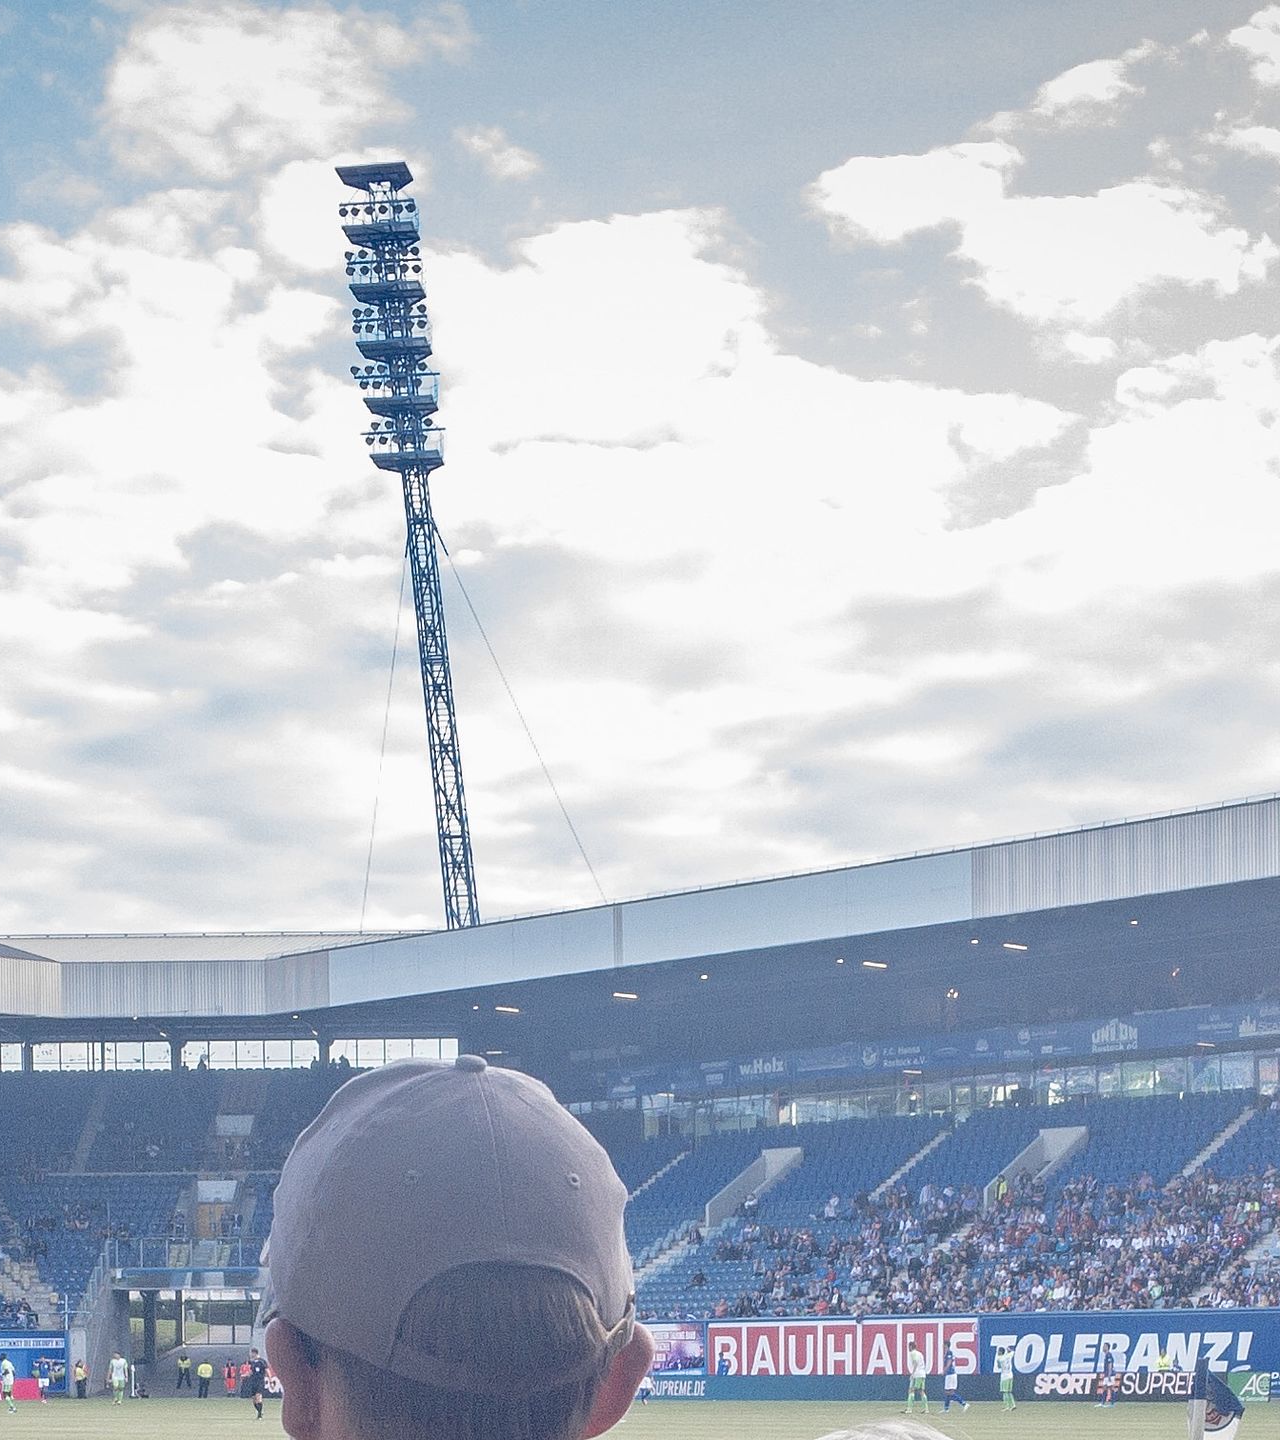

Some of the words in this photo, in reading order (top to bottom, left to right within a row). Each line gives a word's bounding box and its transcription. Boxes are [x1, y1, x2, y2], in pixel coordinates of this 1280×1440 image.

[714, 1332, 977, 1375] BAUHAUS
[990, 1332, 1254, 1373] TOLERANZ!
[1034, 1373, 1097, 1395] SPORT
